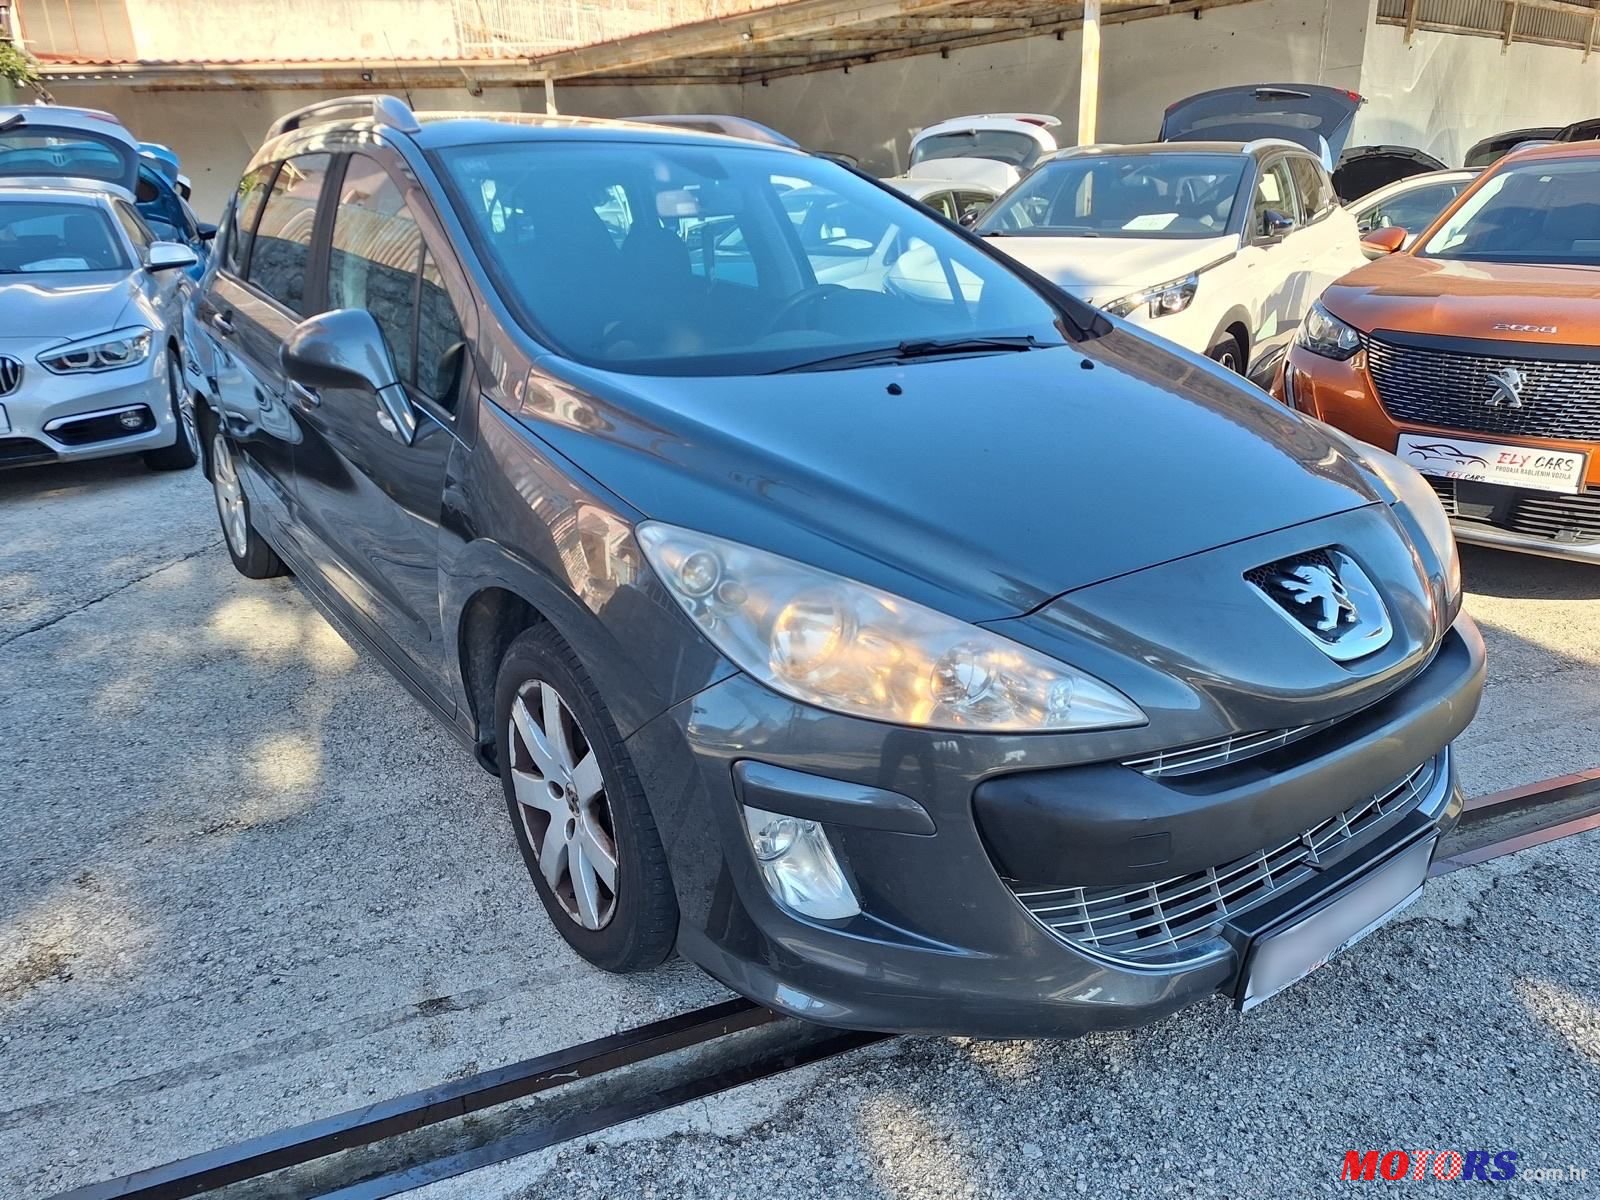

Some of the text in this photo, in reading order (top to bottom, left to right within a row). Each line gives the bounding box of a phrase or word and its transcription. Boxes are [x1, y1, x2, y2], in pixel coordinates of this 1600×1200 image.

[1497, 452, 1574, 472] ELY CARS
[1495, 465, 1519, 474] PRODAJA
